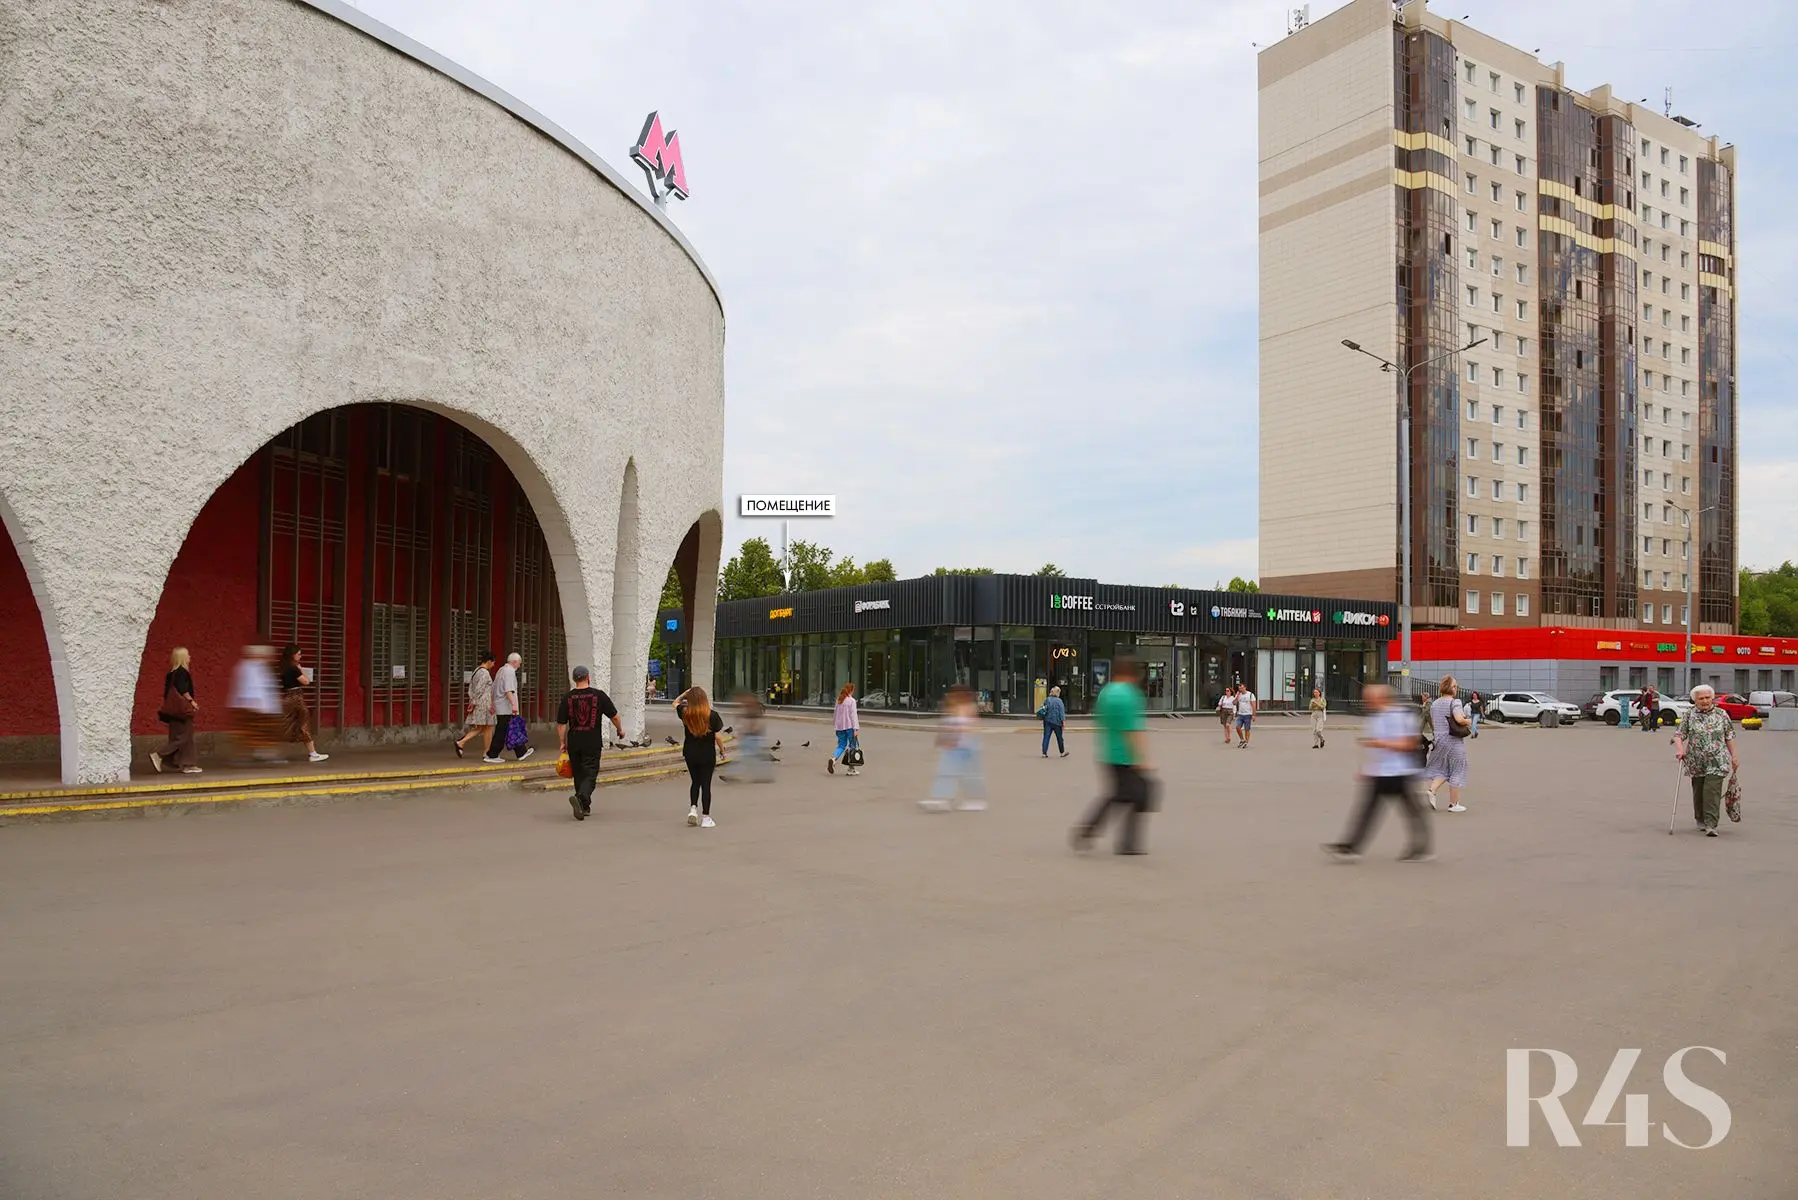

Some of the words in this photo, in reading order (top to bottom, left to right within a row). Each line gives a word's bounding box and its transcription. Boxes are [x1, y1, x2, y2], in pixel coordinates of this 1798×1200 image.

[1062, 595, 1094, 610] COFFEE
[1276, 609, 1312, 622] АПТЕКА
[1342, 611, 1376, 625] ДИКСИ
